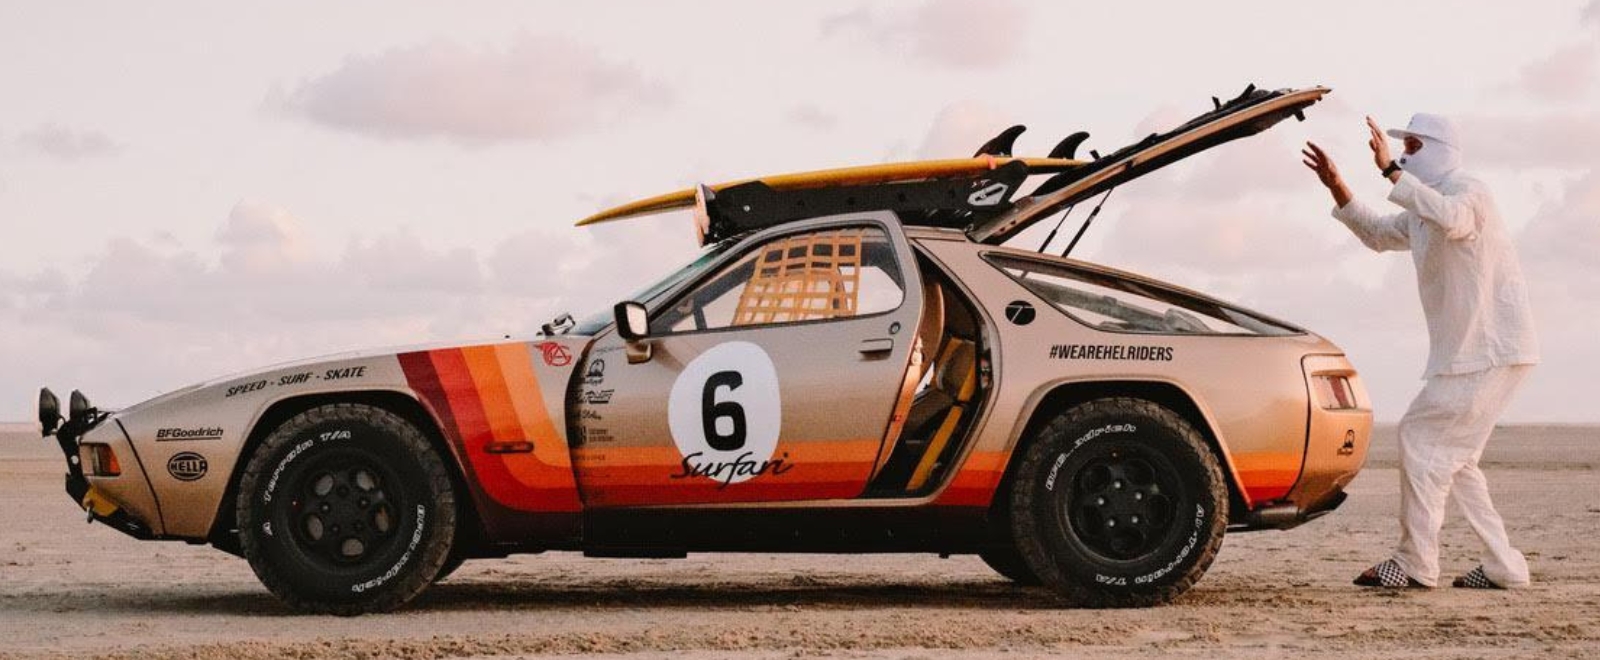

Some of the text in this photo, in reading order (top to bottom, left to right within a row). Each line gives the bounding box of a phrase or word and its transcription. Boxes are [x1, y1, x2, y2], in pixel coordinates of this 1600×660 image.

[1049, 344, 1174, 361] #WEAREHELRIDERS
[226, 380, 267, 397] SPEED
[278, 372, 313, 386] SURF
[324, 366, 366, 380] SKATE
[702, 370, 747, 451] 6
[157, 426, 224, 438] BFGoodrich
[320, 430, 351, 442] T/A
[670, 451, 794, 490] Surfari
[1096, 573, 1127, 586] T/A
